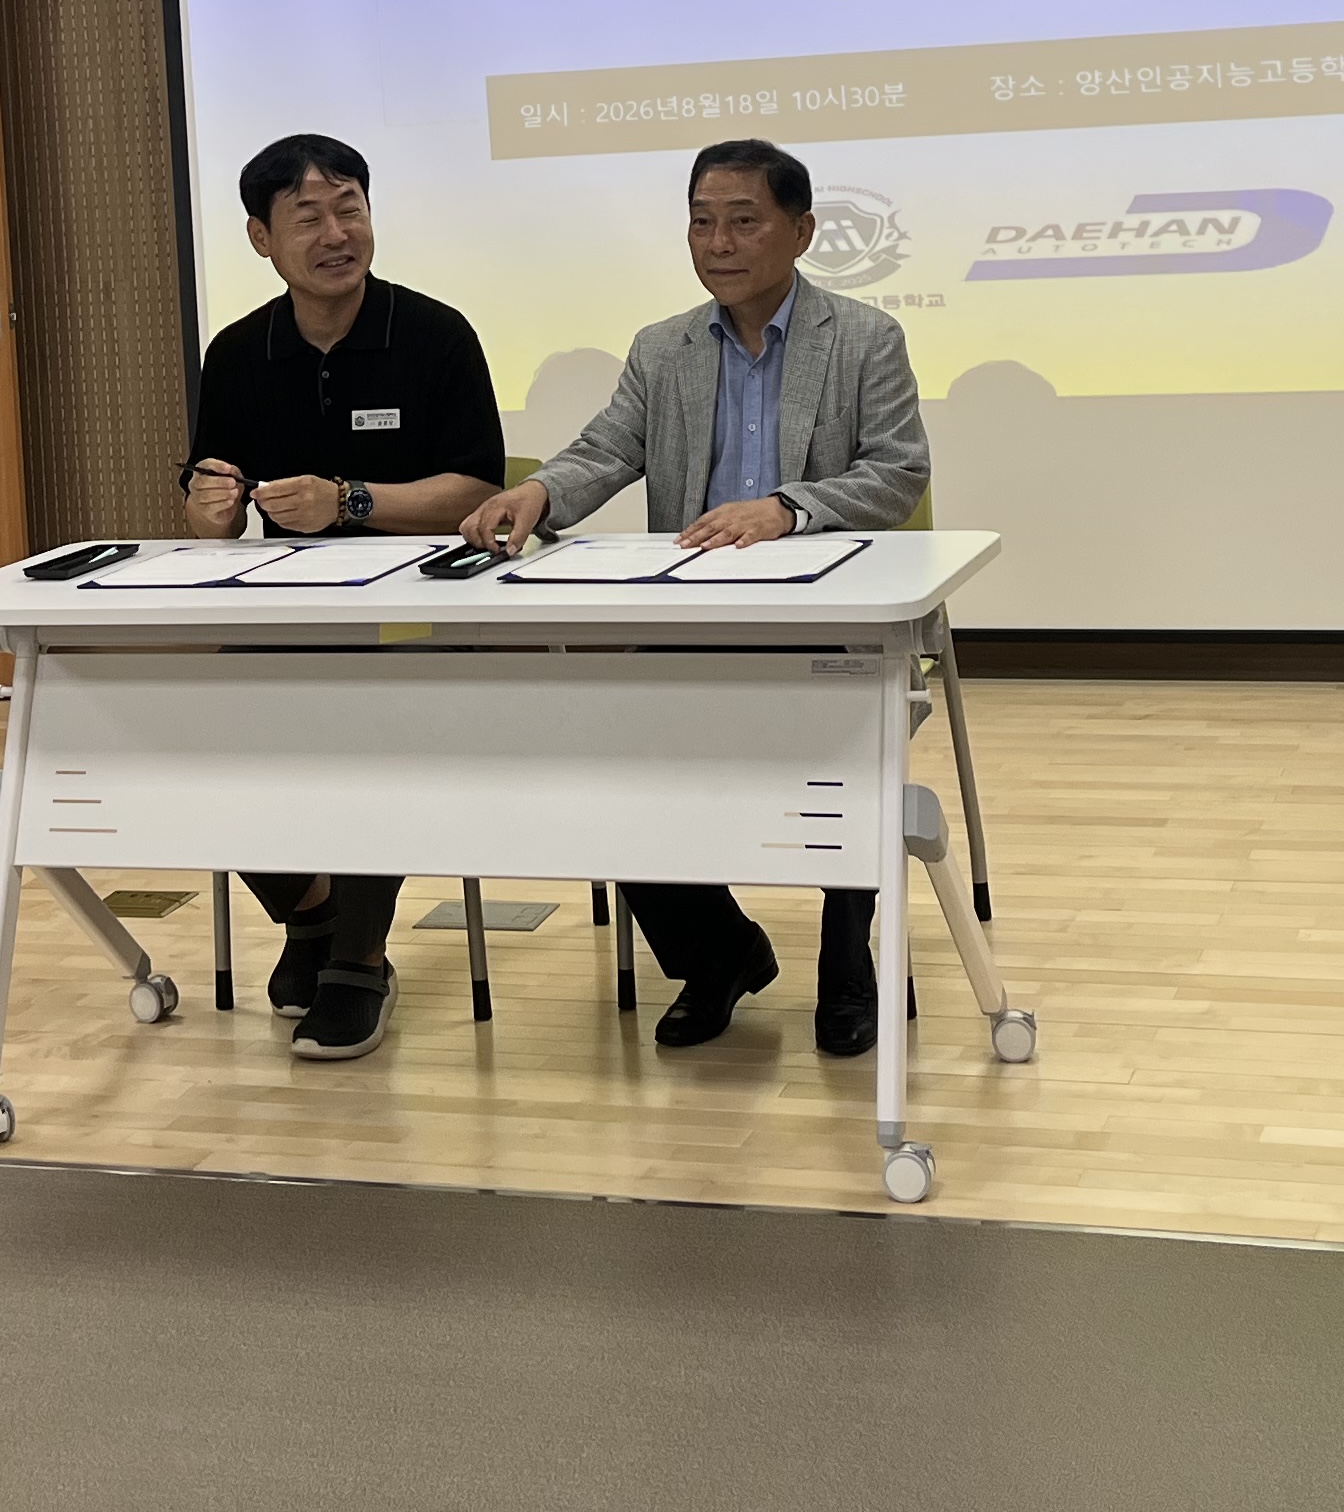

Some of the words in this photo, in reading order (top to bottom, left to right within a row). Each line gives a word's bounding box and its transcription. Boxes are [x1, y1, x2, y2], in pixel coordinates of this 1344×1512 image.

[989, 73, 1047, 101] 장소
[520, 102, 569, 129] 일시
[595, 89, 780, 123] 2026년8월18일
[791, 82, 908, 111] 10시30분
[985, 216, 1241, 244] DAEHAN
[981, 238, 1233, 256] AUTOTECH
